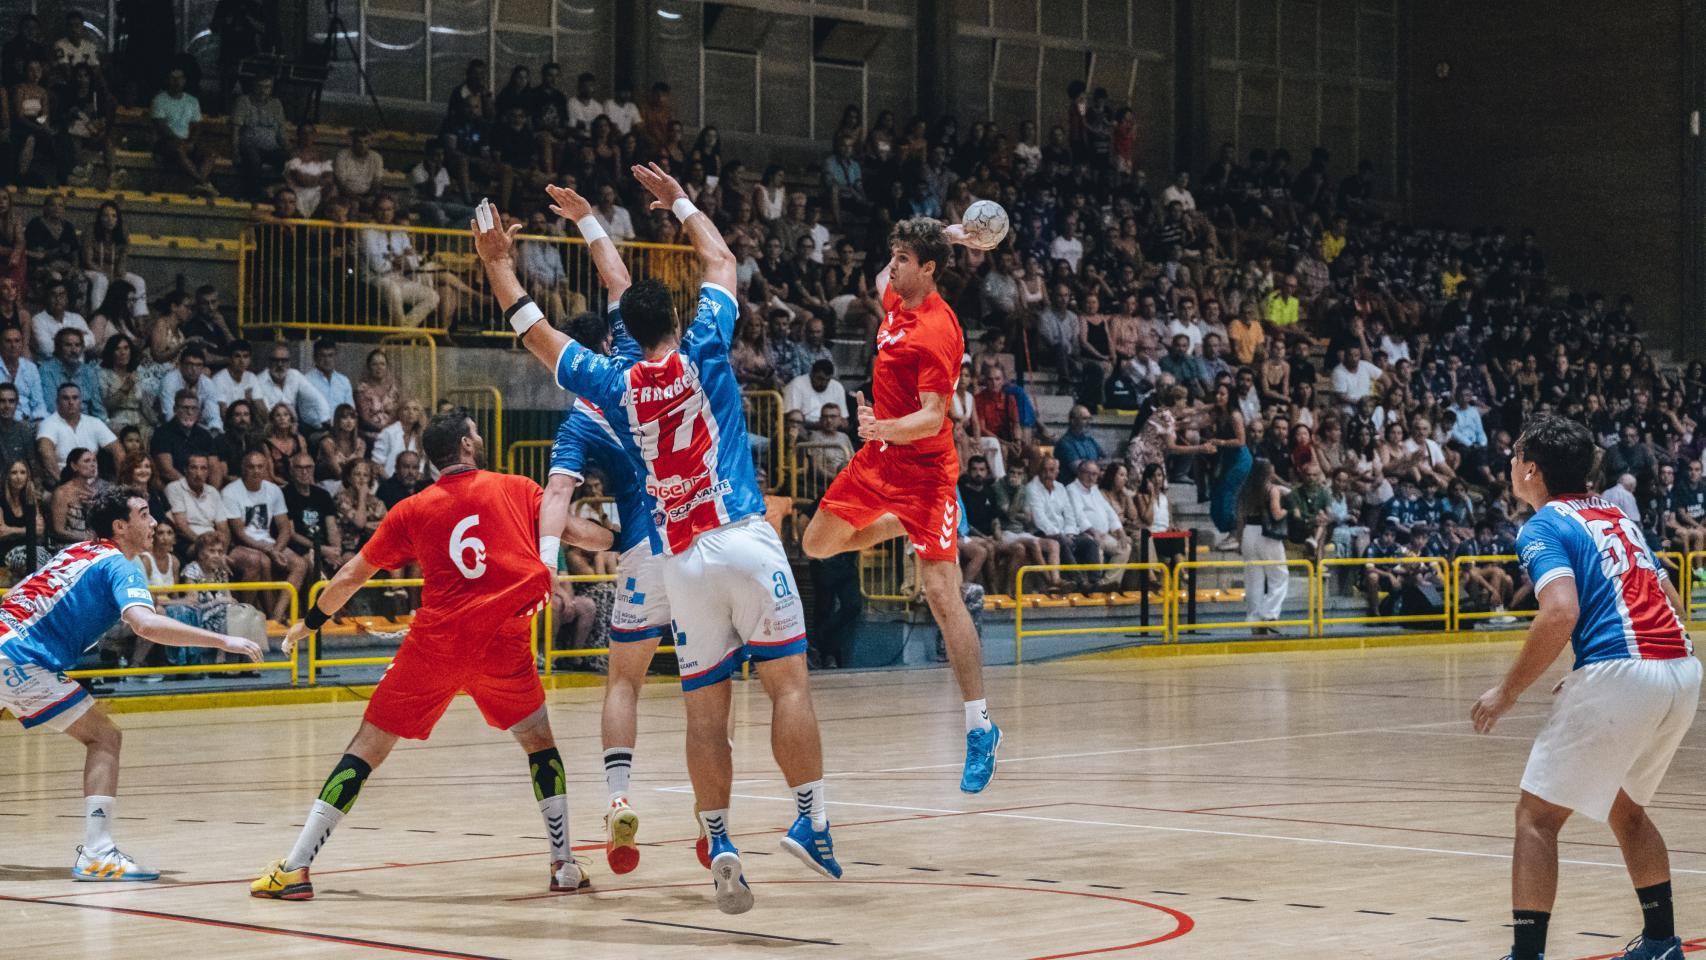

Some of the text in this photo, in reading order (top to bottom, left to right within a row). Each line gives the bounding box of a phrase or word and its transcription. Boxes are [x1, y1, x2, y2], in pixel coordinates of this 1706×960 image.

[638, 388, 705, 462] 17
[448, 513, 487, 579] 6
[1585, 517, 1656, 579] 59
